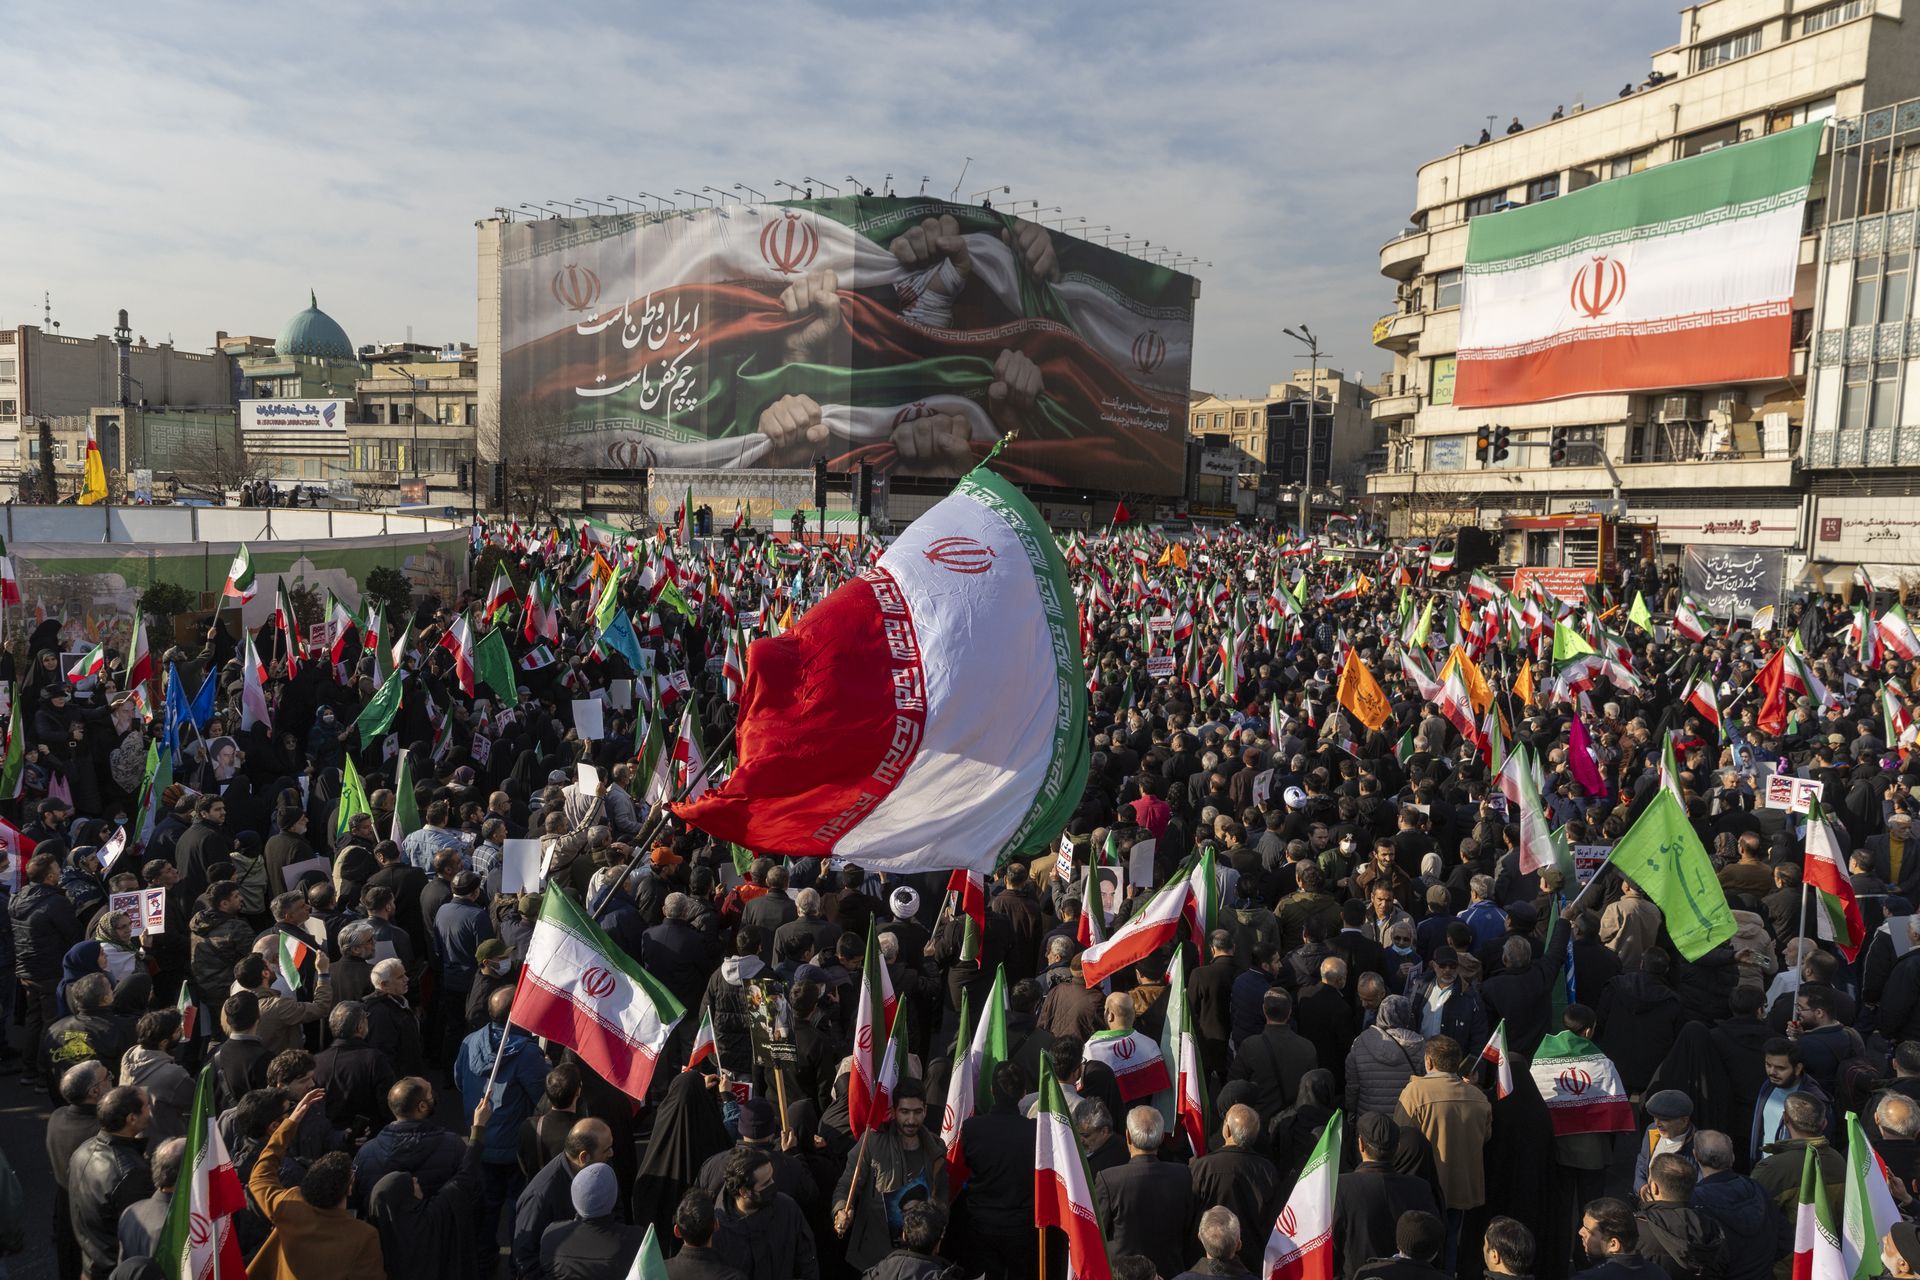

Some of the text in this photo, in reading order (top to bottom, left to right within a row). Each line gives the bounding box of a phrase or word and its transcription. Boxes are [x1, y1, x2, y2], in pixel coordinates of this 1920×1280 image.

[576, 291, 700, 350] ایران وطن ماست
[575, 338, 700, 430] پرچم کفن ماست
[1436, 388, 1453, 398] POL
[300, 404, 320, 417] بانک
[1707, 553, 1763, 573] مثل سیاوش تنها
[1725, 577, 1738, 591] این
[1736, 578, 1744, 589] از
[1743, 571, 1766, 591] بگذر
[1708, 595, 1728, 608] ایران
[1738, 598, 1752, 609] ای
